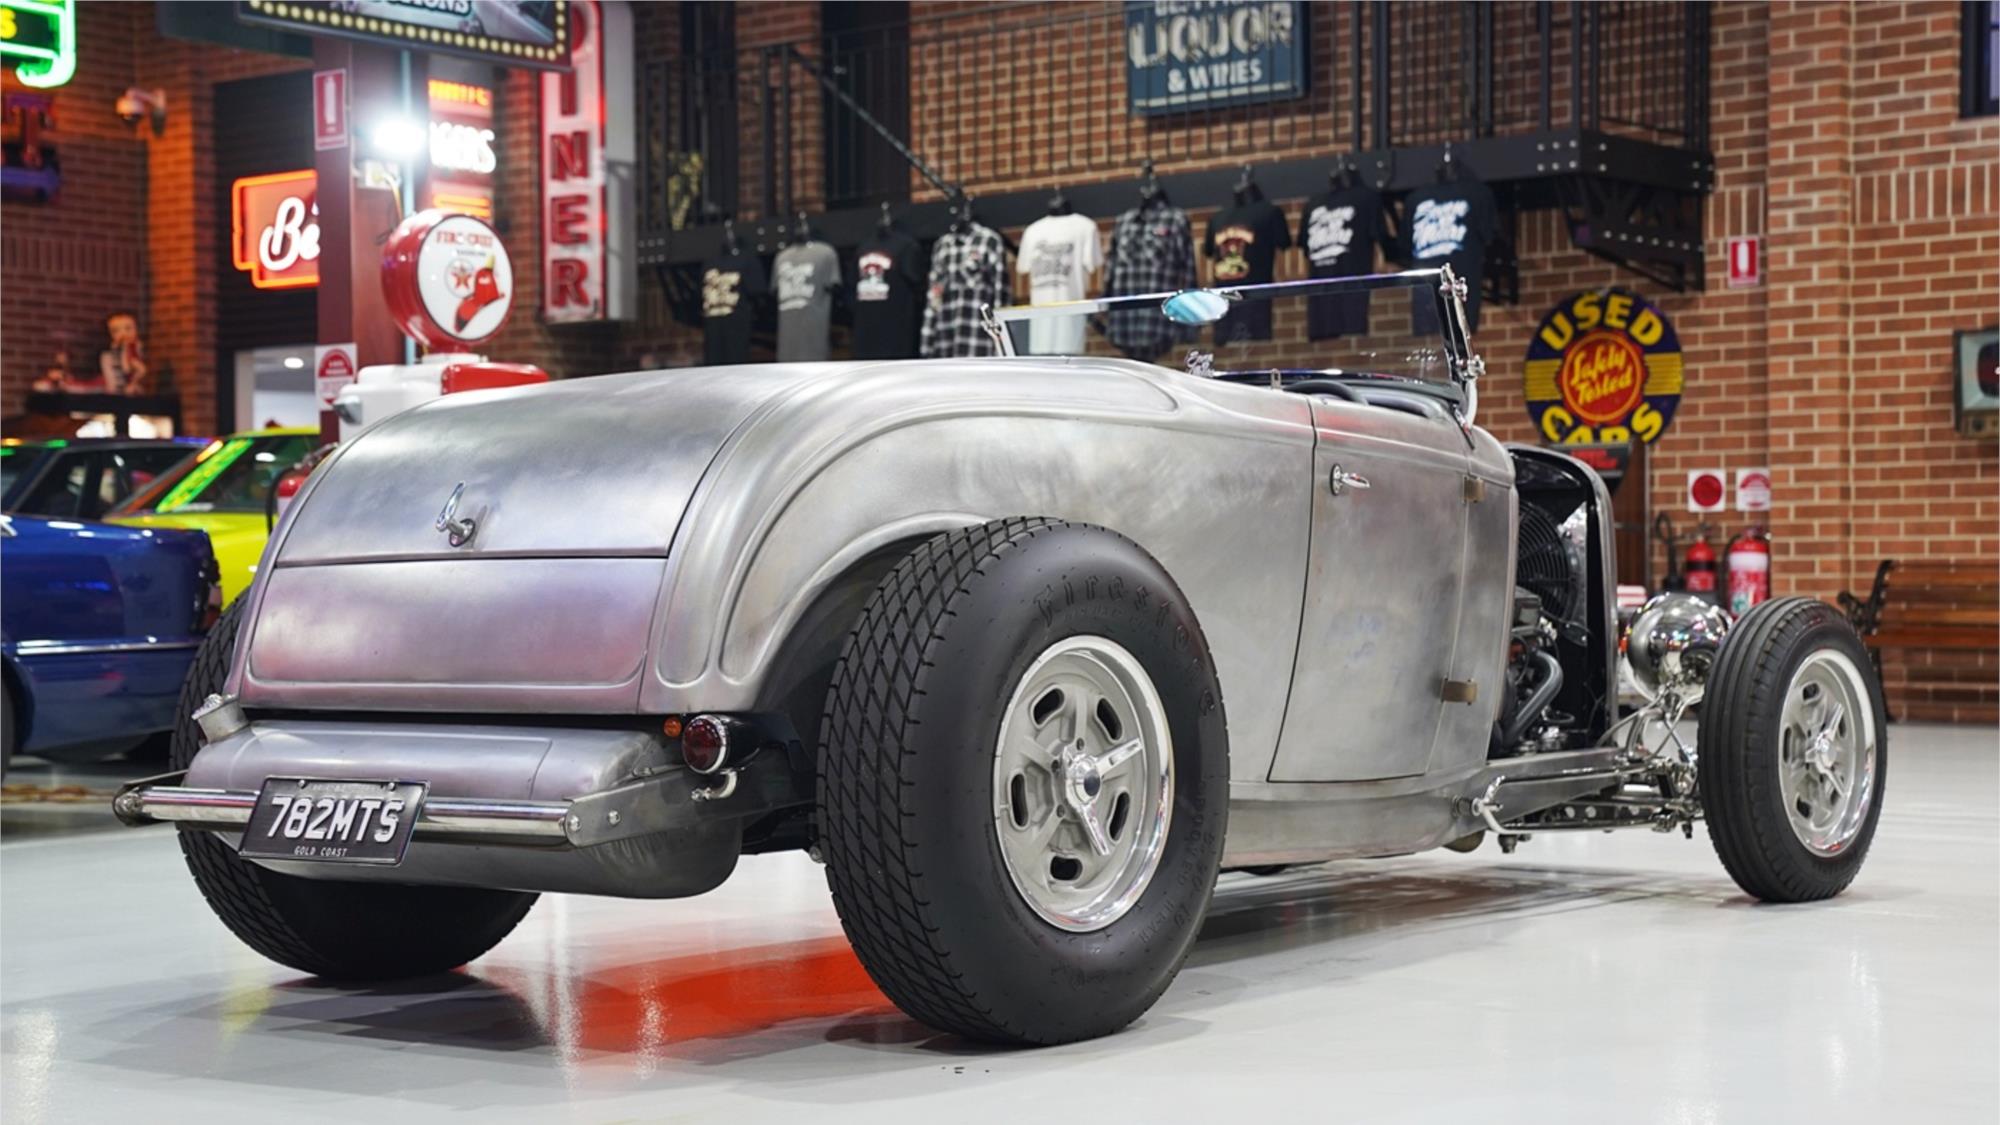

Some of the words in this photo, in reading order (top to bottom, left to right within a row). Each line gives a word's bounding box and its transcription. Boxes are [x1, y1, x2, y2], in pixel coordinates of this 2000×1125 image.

[1168, 68, 1186, 93] &
[1189, 58, 1263, 90] WINES
[1540, 293, 1664, 350] USED
[1571, 344, 1627, 386] Safety
[1576, 365, 1634, 405] Tested
[1541, 402, 1664, 445] CARS
[267, 796, 404, 843] 782MTS
[294, 845, 317, 856] GOLD
[320, 847, 348, 858] COAST
